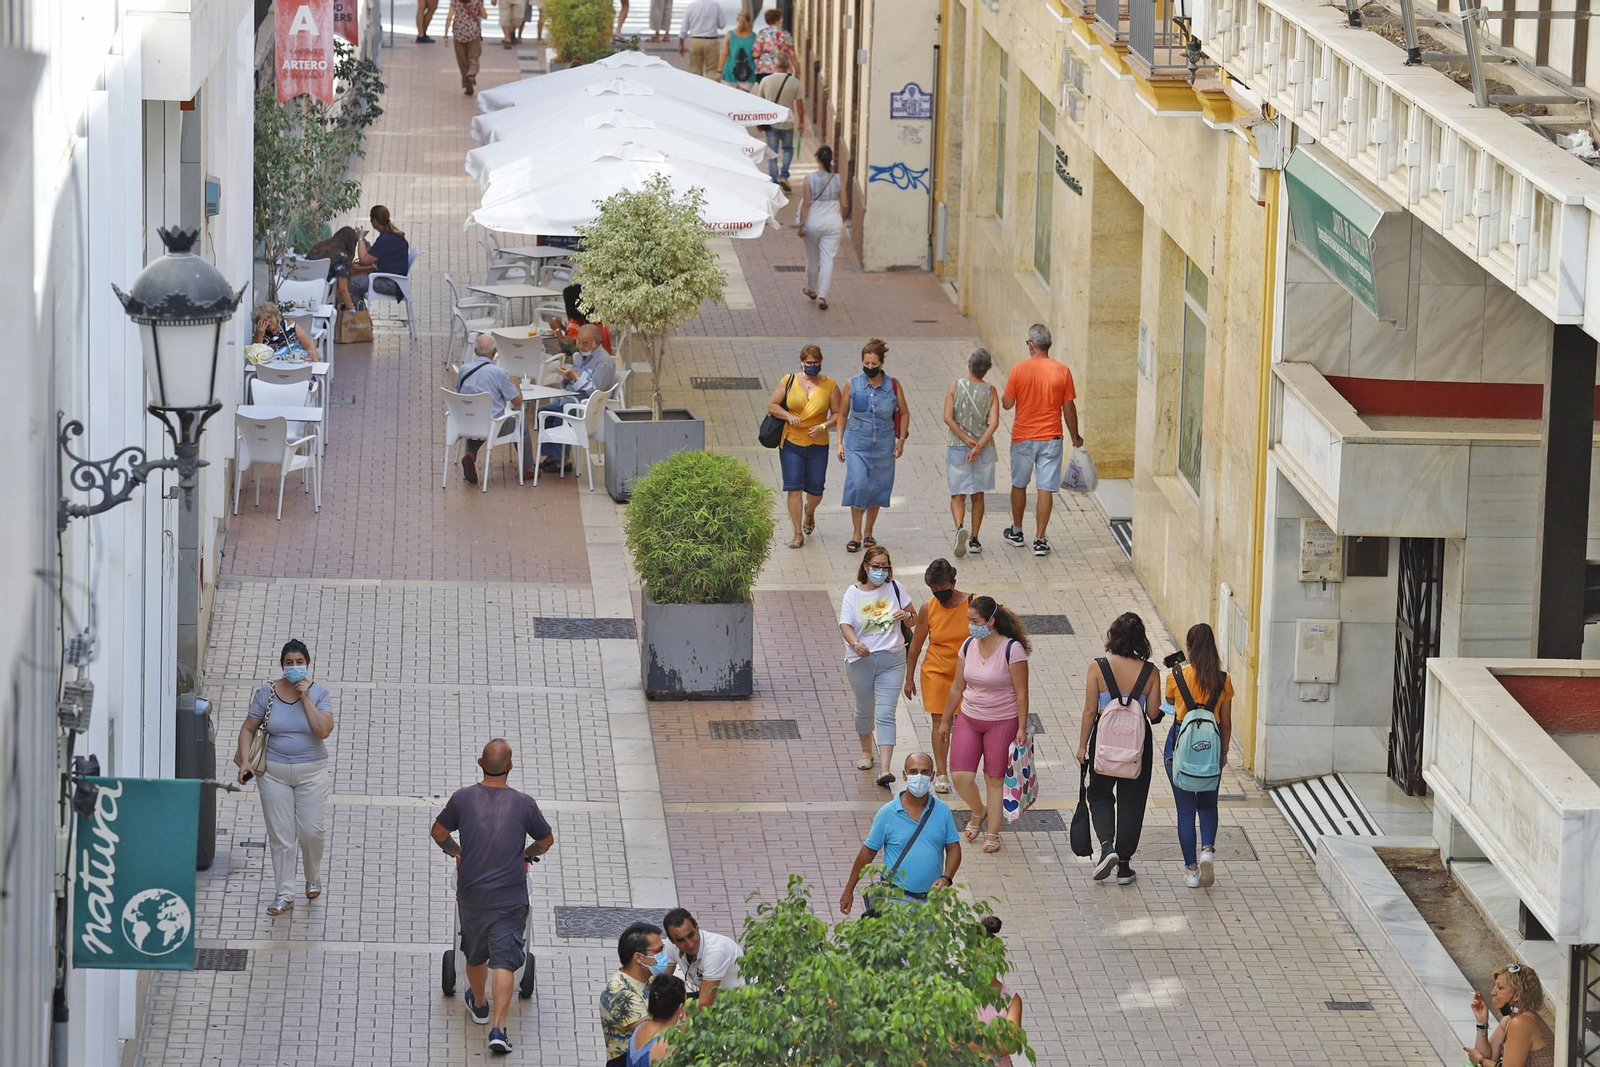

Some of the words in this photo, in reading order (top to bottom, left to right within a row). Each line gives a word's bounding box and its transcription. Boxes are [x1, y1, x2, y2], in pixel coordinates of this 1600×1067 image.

[288, 5, 320, 35] A
[282, 60, 328, 70] ARTERO
[79, 780, 123, 955] natura
